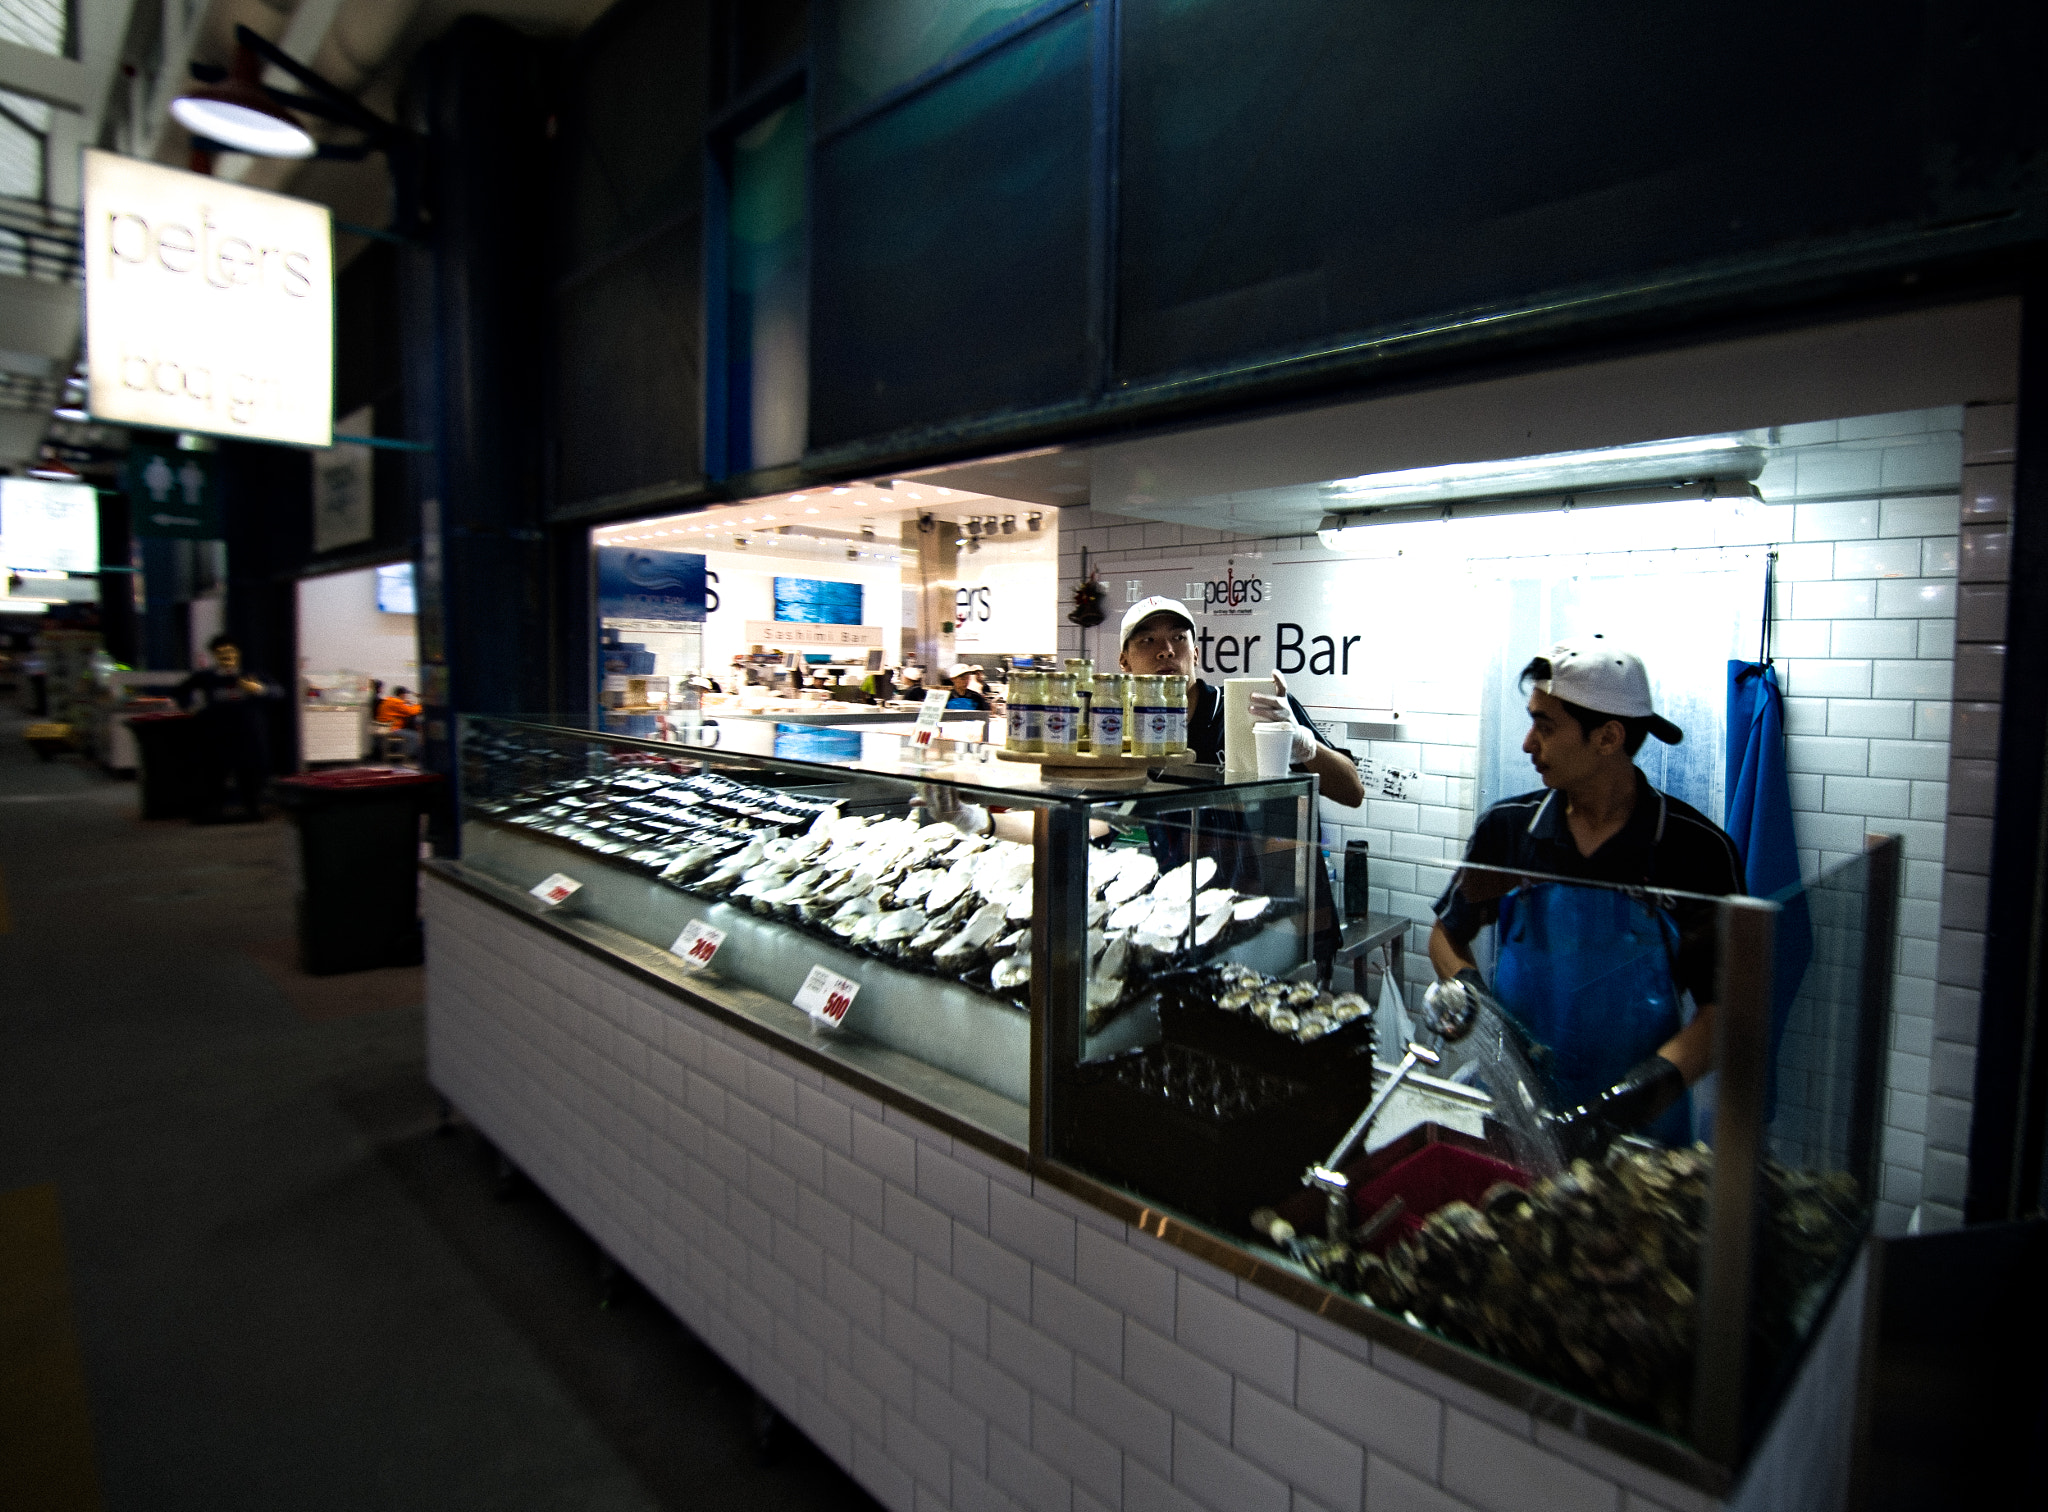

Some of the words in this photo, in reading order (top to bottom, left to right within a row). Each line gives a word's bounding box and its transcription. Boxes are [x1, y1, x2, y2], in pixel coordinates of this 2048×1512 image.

[1204, 568, 1262, 614] peter's
[763, 628, 835, 641] Sashimi
[841, 631, 868, 643] Bar
[1198, 626, 1261, 674] ter
[1276, 622, 1361, 676] Bar
